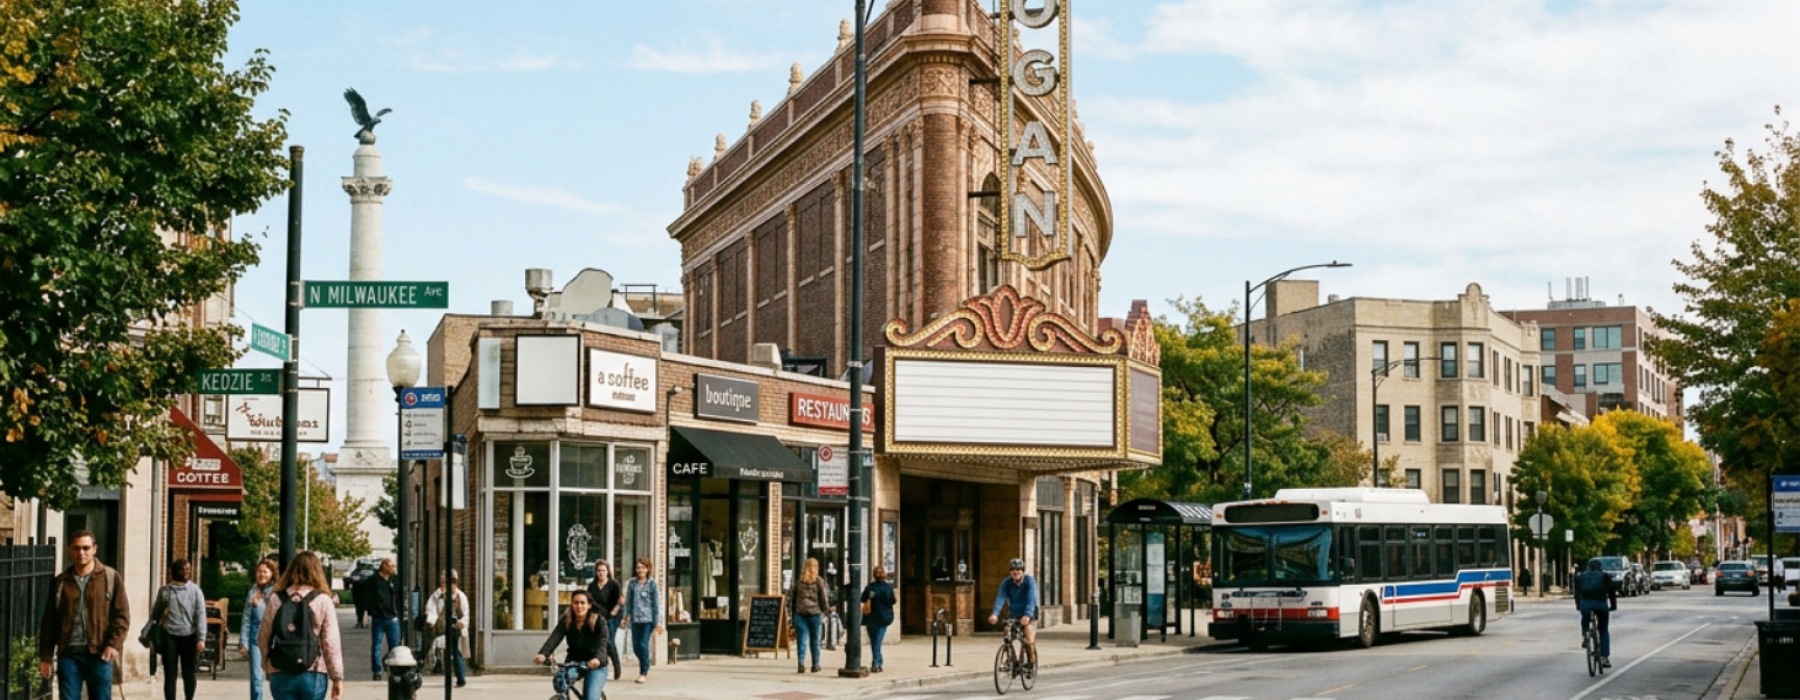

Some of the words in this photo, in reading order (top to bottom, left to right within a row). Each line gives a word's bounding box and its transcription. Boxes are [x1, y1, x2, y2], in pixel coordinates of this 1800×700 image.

[310, 286, 321, 304] N
[328, 286, 417, 304] MILWAUKEE
[202, 373, 254, 391] KEDZIE
[672, 462, 708, 475] CAFE
